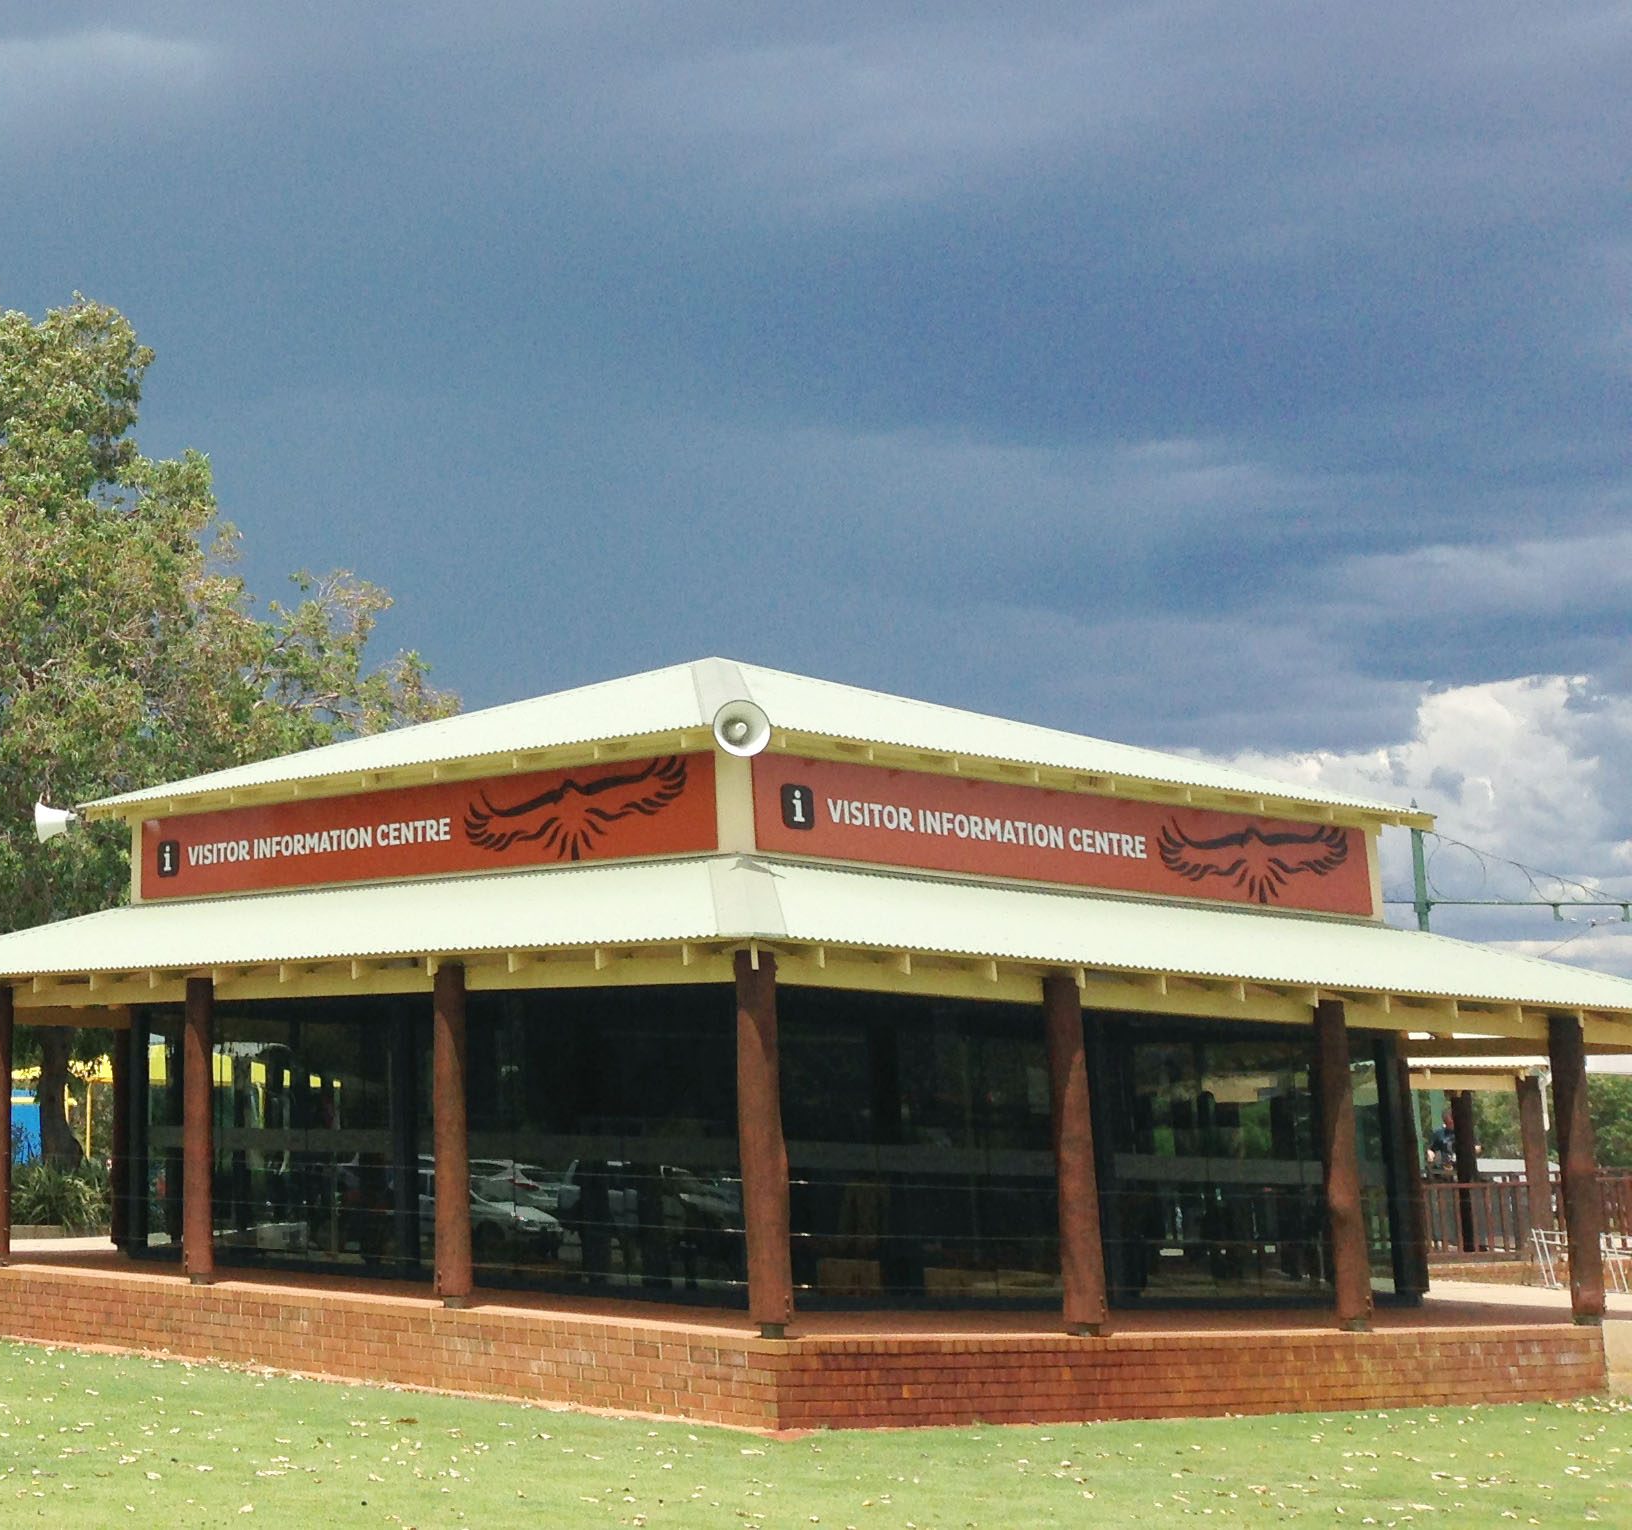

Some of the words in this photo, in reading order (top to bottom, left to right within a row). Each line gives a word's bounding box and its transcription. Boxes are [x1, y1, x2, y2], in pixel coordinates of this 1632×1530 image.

[188, 839, 250, 867] VISITOR
[253, 826, 373, 860] INFORMATION
[376, 817, 452, 847] CENTRE
[827, 798, 915, 833] VISITOR
[918, 809, 1065, 850] INFORMATION
[1068, 828, 1148, 860] CENTRE
